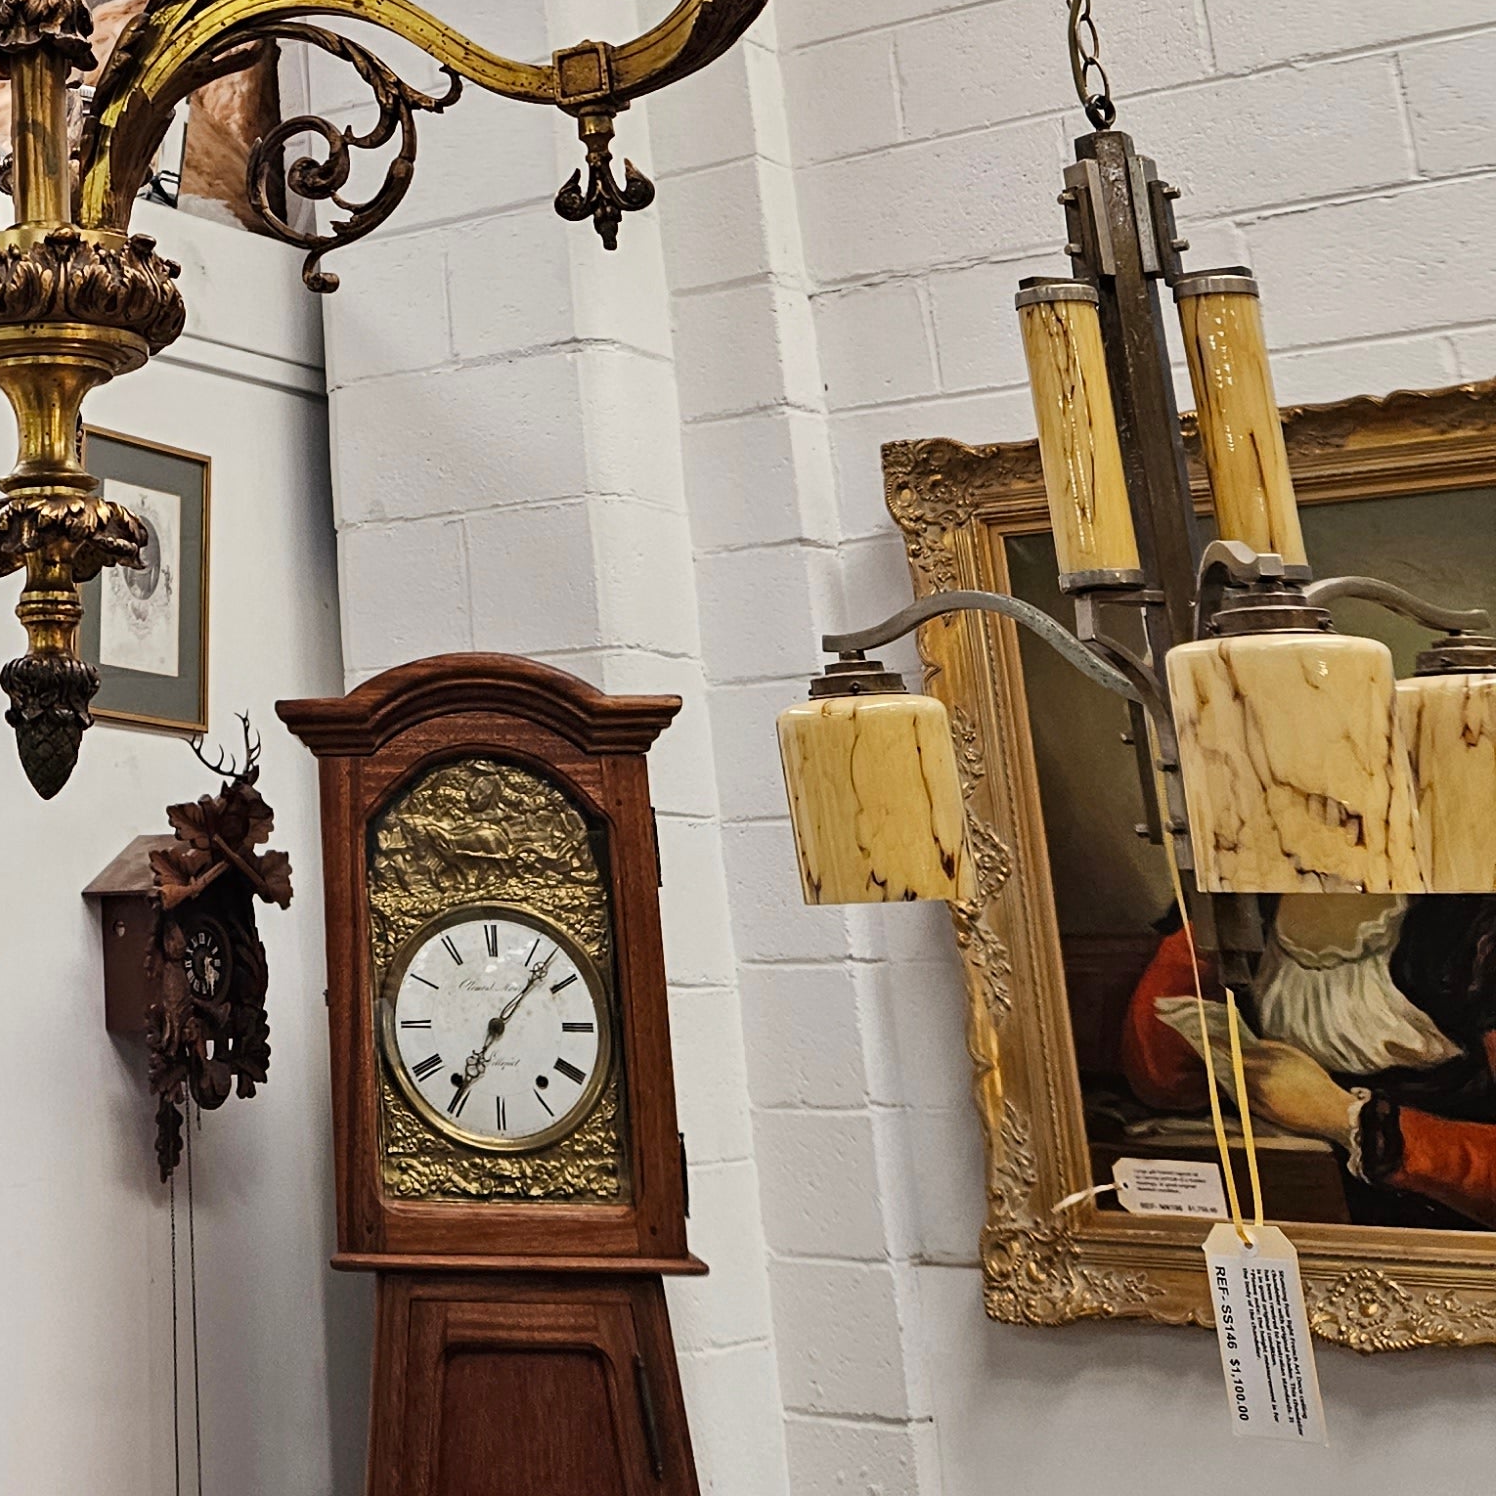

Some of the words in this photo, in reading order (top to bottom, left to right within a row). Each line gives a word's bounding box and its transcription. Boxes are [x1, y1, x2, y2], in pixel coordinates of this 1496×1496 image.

[1214, 1265, 1230, 1301] REF-
[1244, 1281, 1252, 1298] body
[1258, 1284, 1266, 1303] good
[1262, 1303, 1272, 1331] original
[1221, 1304, 1238, 1350] SS146
[1269, 1302, 1279, 1330] rewired
[1276, 1340, 1286, 1376] Australian
[1278, 1270, 1288, 1302] Stunning
[1286, 1319, 1294, 1336] light
[1290, 1337, 1298, 1362] French
[1260, 1330, 1268, 1353] height
[1264, 1354, 1276, 1403] measurement
[1271, 1269, 1282, 1306] chandelier
[1280, 1325, 1290, 1353] original
[1293, 1398, 1304, 1436] chandelier
[1229, 1358, 1250, 1421] $1,100.00
